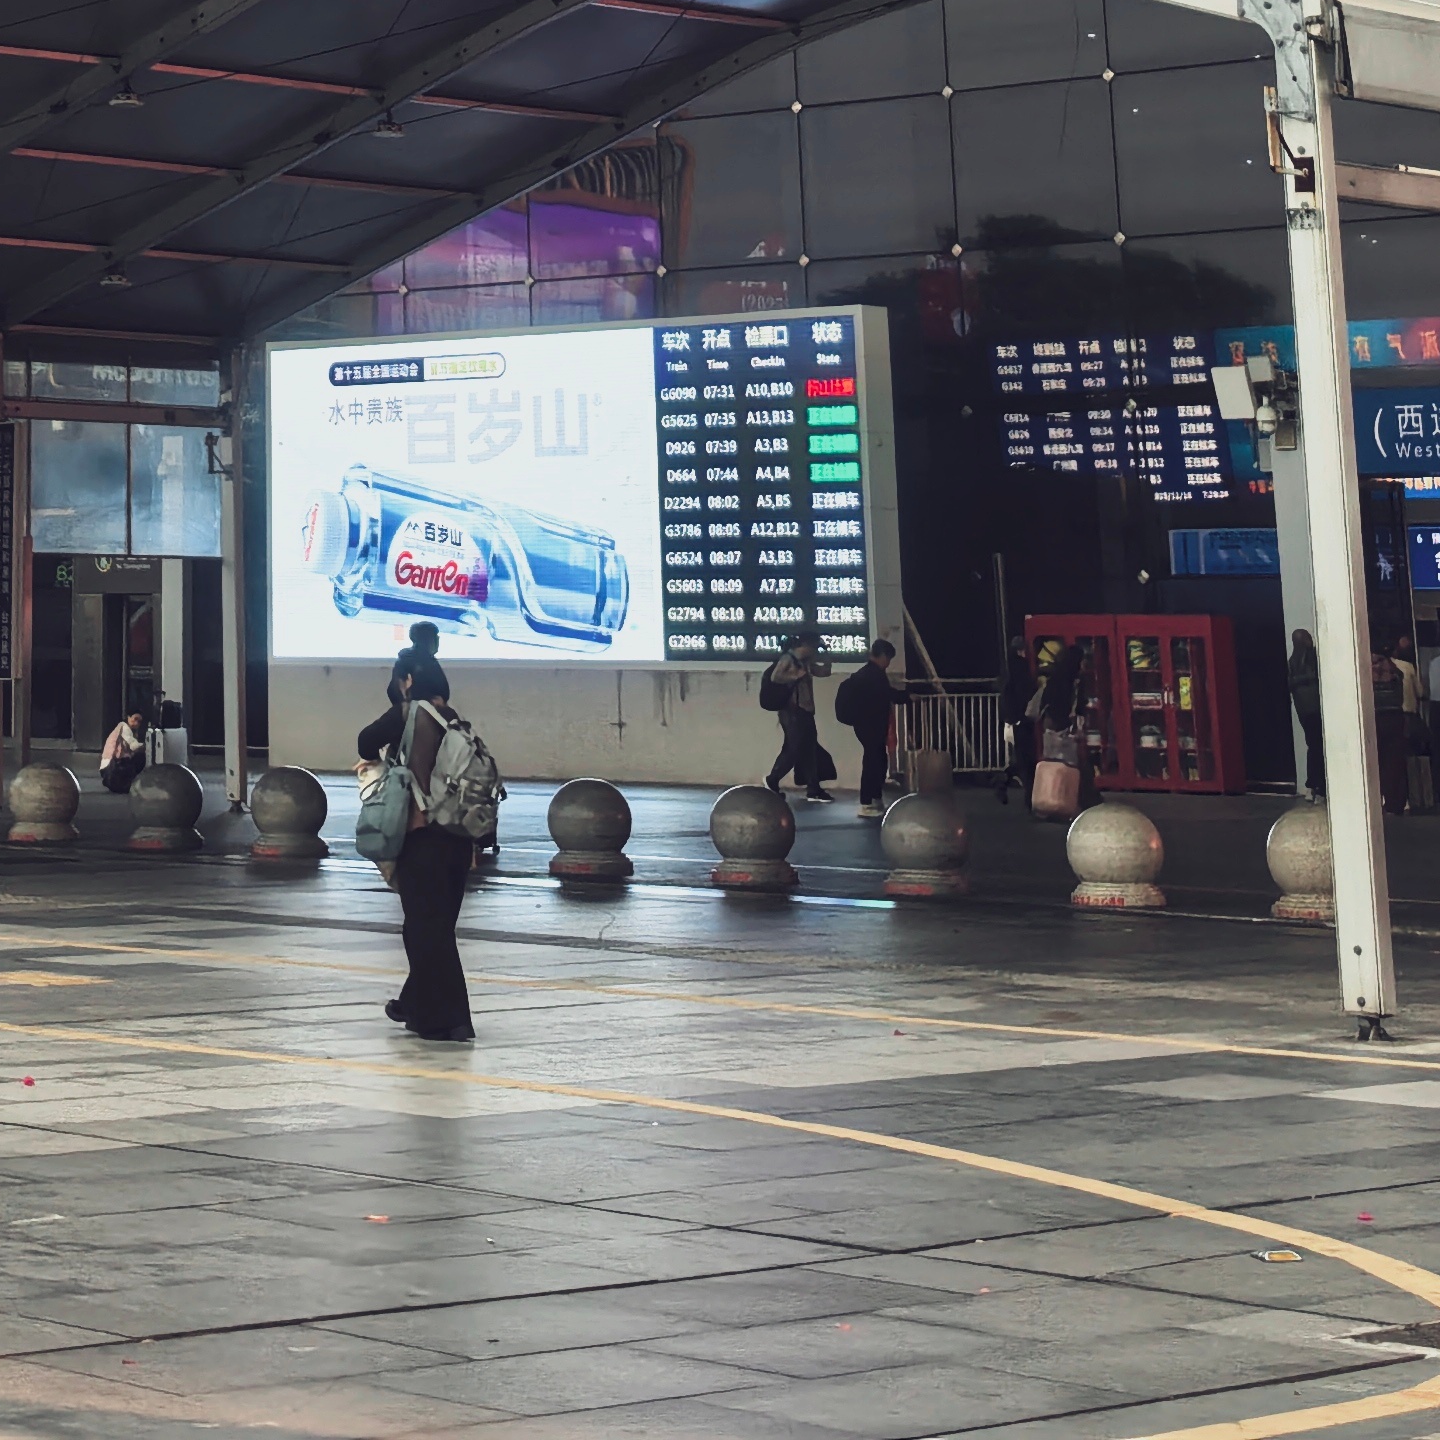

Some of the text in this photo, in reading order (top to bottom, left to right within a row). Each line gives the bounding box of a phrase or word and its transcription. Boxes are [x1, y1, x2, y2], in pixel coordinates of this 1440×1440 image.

[661, 321, 842, 350] 车次 开点 检票口 状态
[334, 362, 419, 381] 第十五届全国运动会
[703, 385, 735, 399] 07:31
[328, 398, 403, 425] 水中贵族
[661, 414, 698, 428] G5625
[704, 412, 736, 426] 07:35
[405, 388, 590, 465] 百岁山
[666, 442, 696, 456] D926
[706, 440, 737, 454] 07:39
[1395, 442, 1440, 458] West
[667, 470, 697, 483] D664
[707, 468, 739, 482] 07:44
[665, 496, 701, 509] D2294
[707, 495, 739, 509] 08:02
[812, 492, 859, 509] 正在候车
[425, 522, 462, 546] 百岁山
[708, 523, 740, 537] 08:05
[813, 520, 860, 537] 正在候车
[666, 551, 702, 565] G6524
[709, 551, 741, 564] 08:07
[814, 548, 862, 565] 正在候车
[395, 551, 468, 596] Ganten
[710, 579, 743, 593] 08:09
[816, 577, 864, 594] 正在候车
[668, 607, 705, 621] G2794
[711, 606, 744, 621] 08:10
[817, 606, 865, 622] 正在候车
[712, 635, 745, 648] 08:10
